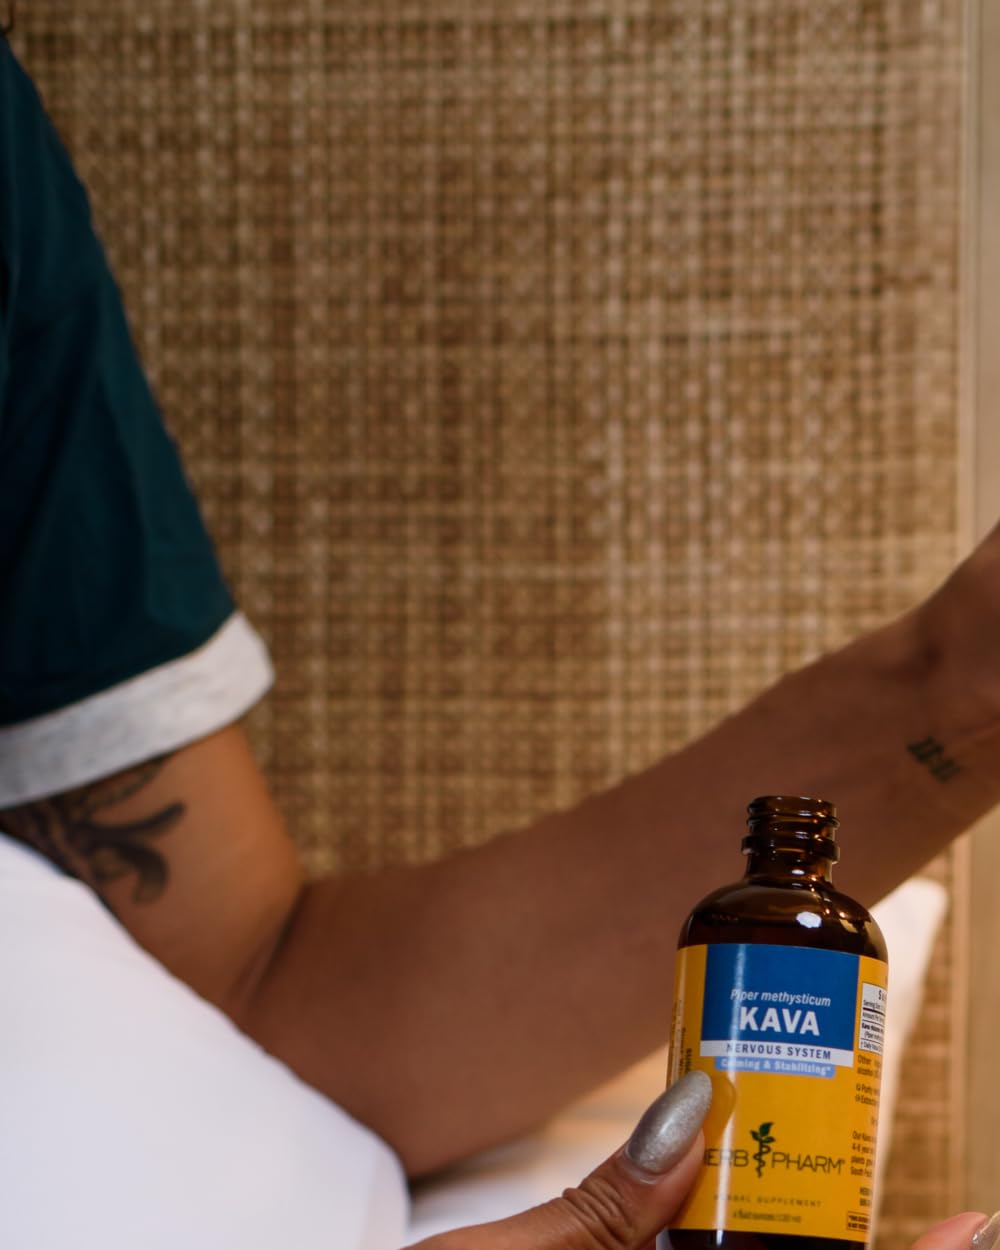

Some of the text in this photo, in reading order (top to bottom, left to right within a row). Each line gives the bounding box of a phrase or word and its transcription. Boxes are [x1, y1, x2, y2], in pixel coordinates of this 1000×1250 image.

[730, 988, 831, 1007] Piper methysticum
[739, 1006, 820, 1036] KAVA
[726, 1043, 831, 1060] NERVOUS SYSTEM
[721, 1058, 760, 1072] Cming
